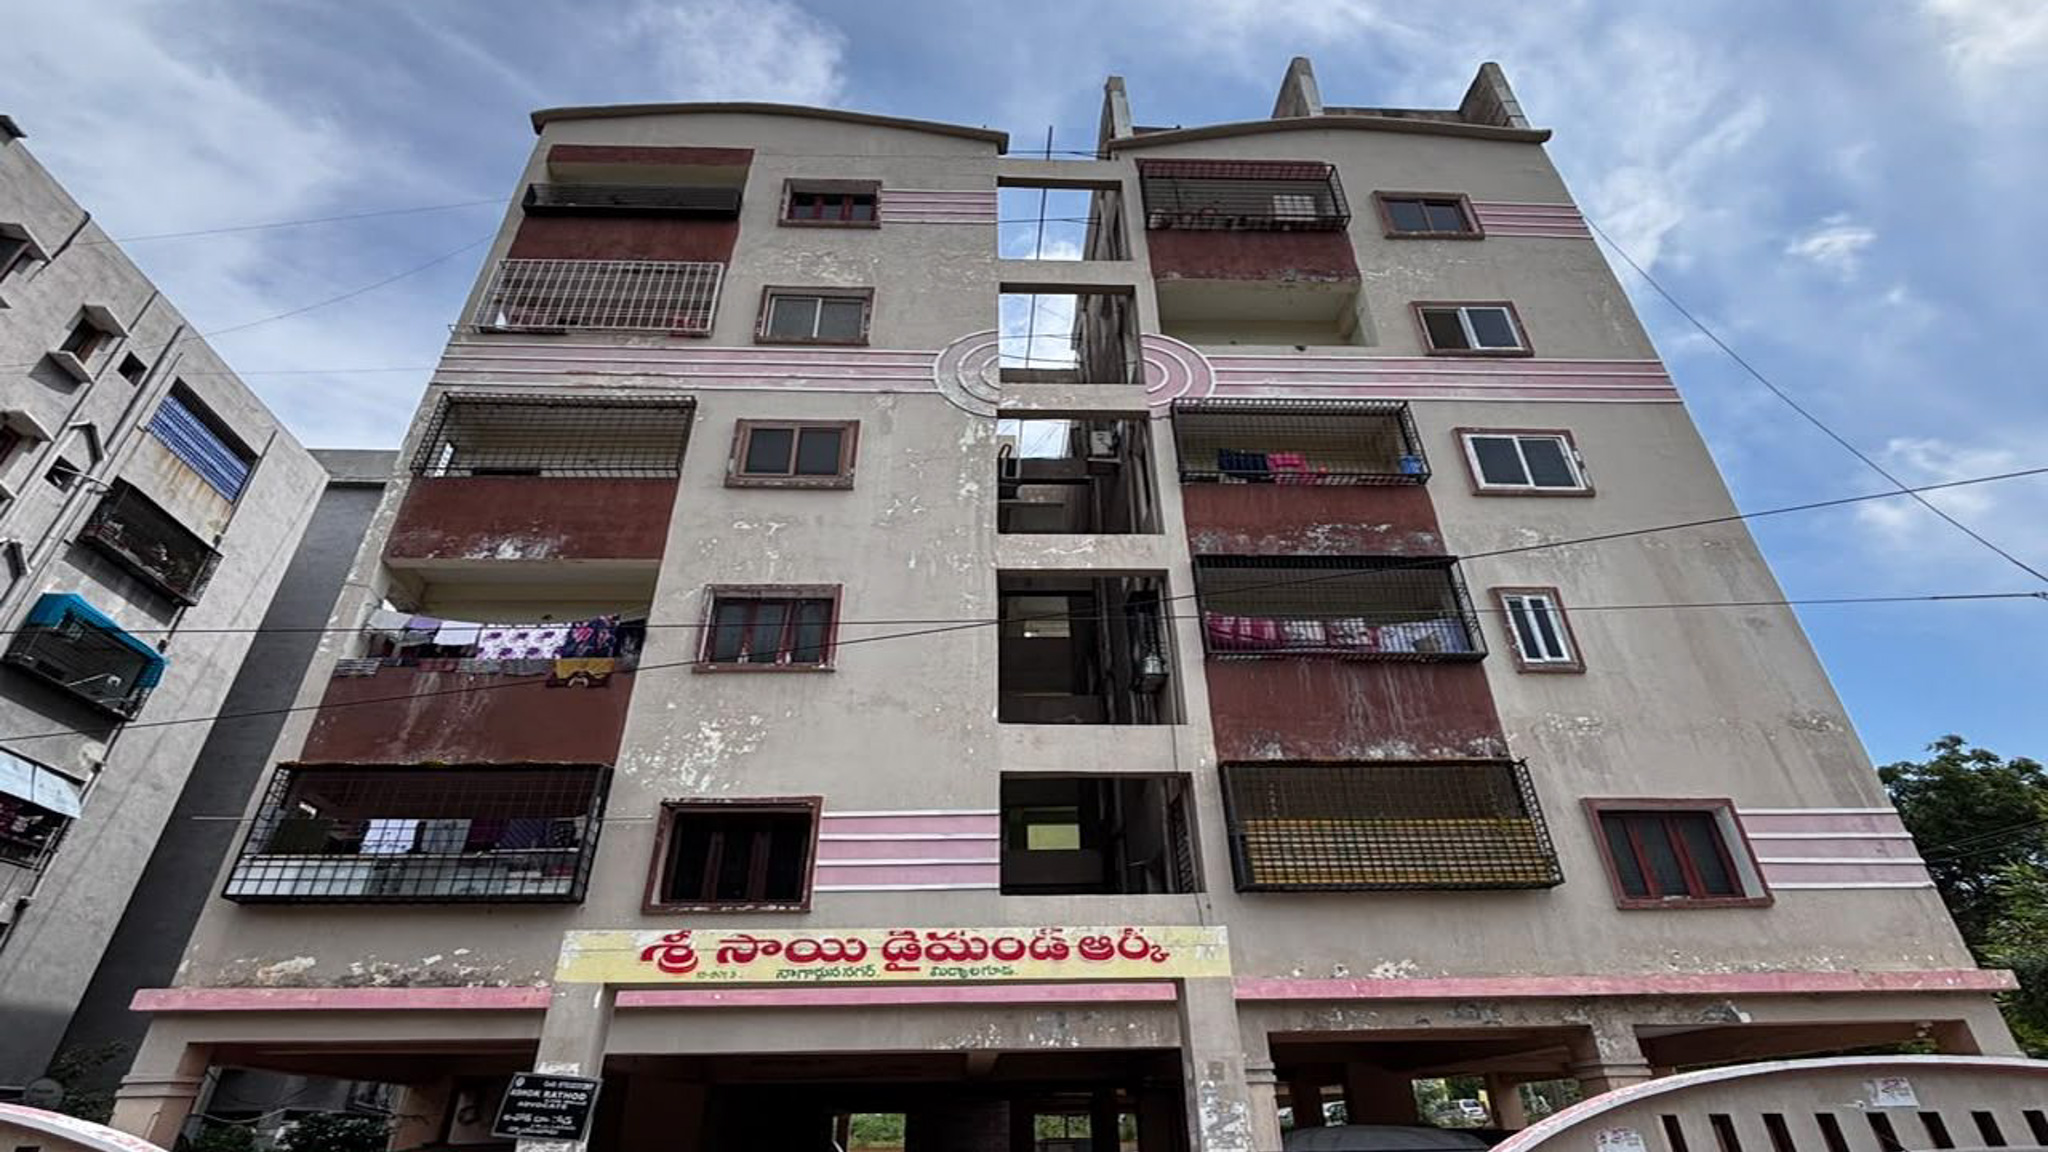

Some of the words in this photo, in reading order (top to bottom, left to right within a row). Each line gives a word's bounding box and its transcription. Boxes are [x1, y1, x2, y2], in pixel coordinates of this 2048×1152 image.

[639, 930, 698, 974] శ్రీ
[716, 934, 867, 963] సాయి
[882, 929, 1070, 971] డైమండ్
